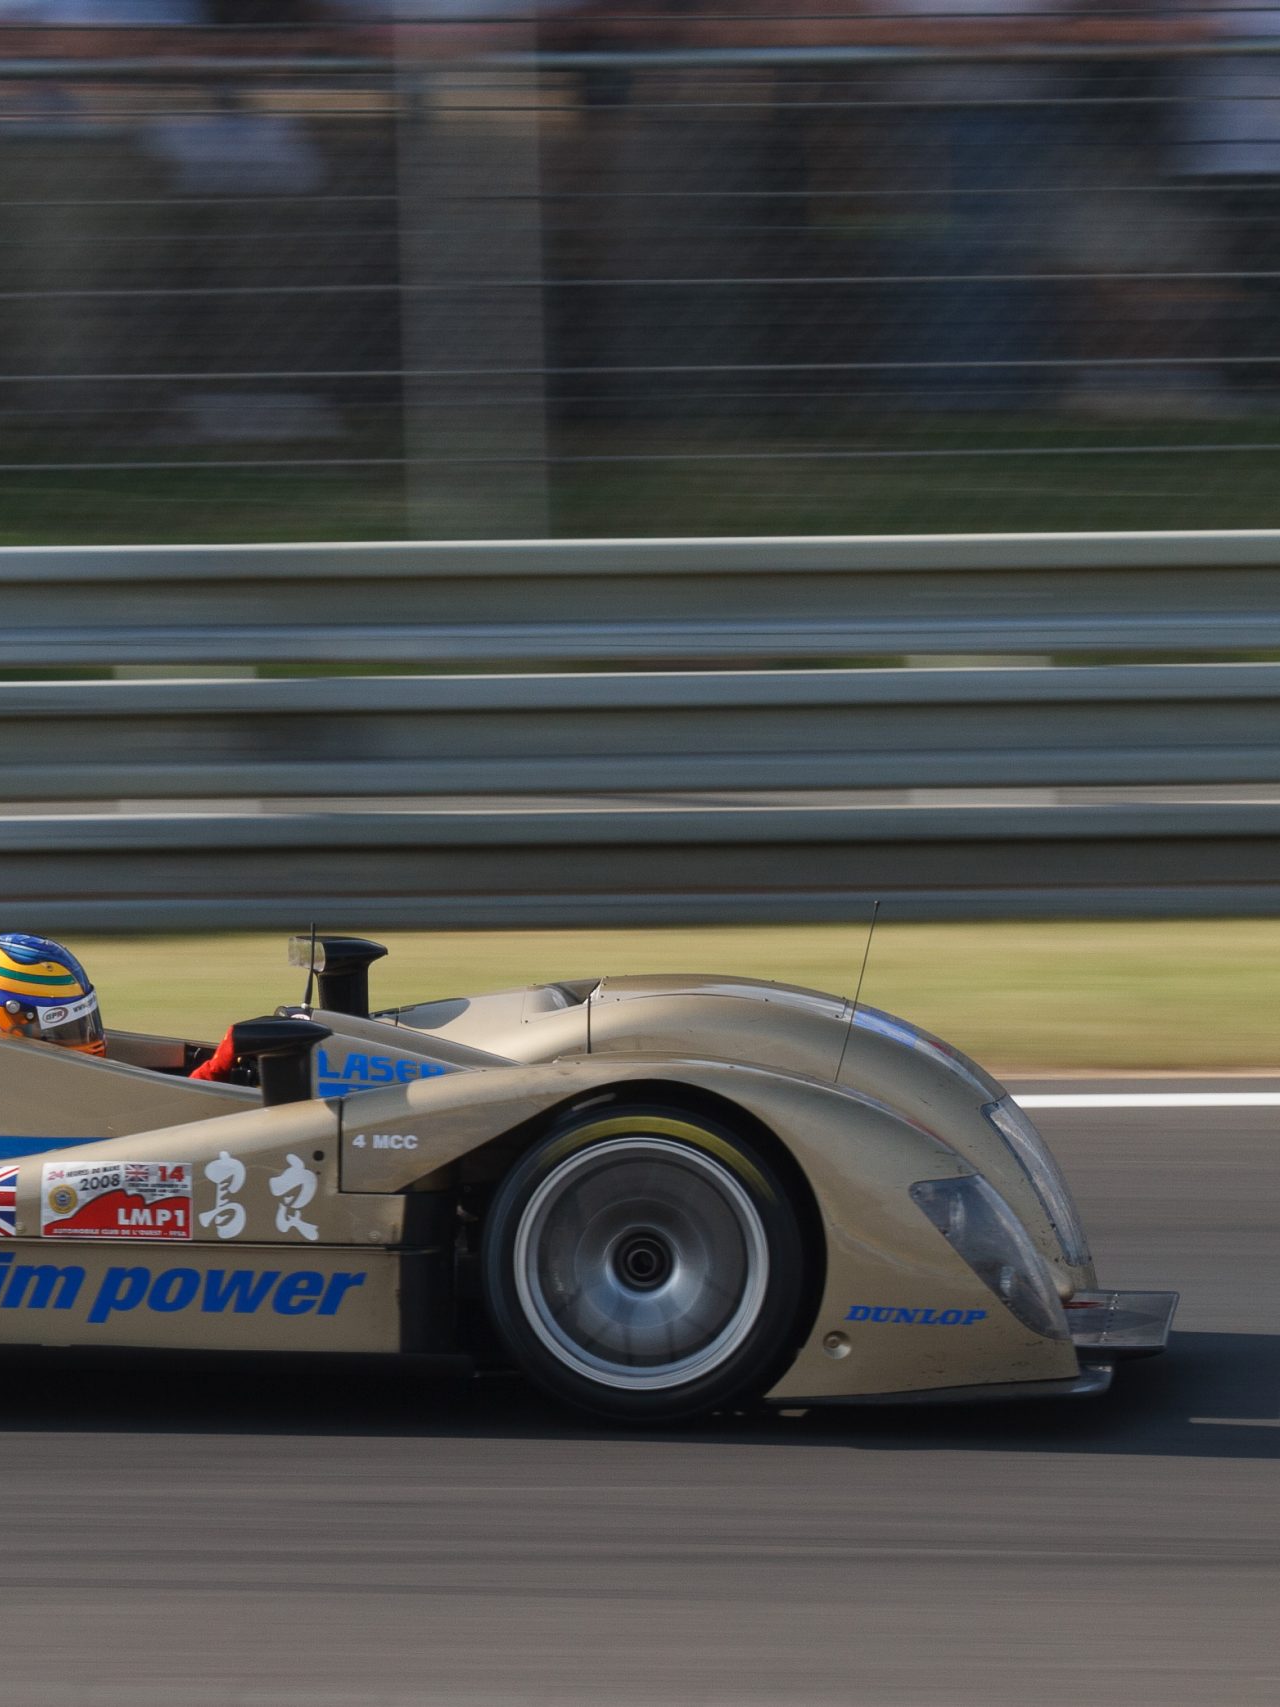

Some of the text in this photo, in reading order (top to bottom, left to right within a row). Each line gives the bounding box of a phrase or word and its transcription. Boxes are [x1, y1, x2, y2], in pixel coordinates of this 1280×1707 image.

[352, 1134, 418, 1149] 4 MCC
[47, 1171, 65, 1180] 24
[80, 1174, 120, 1191] 2008
[158, 1166, 185, 1182] 14
[118, 1208, 184, 1226] LMP1
[87, 1266, 367, 1324] power
[843, 1305, 988, 1326] DUNLOP
